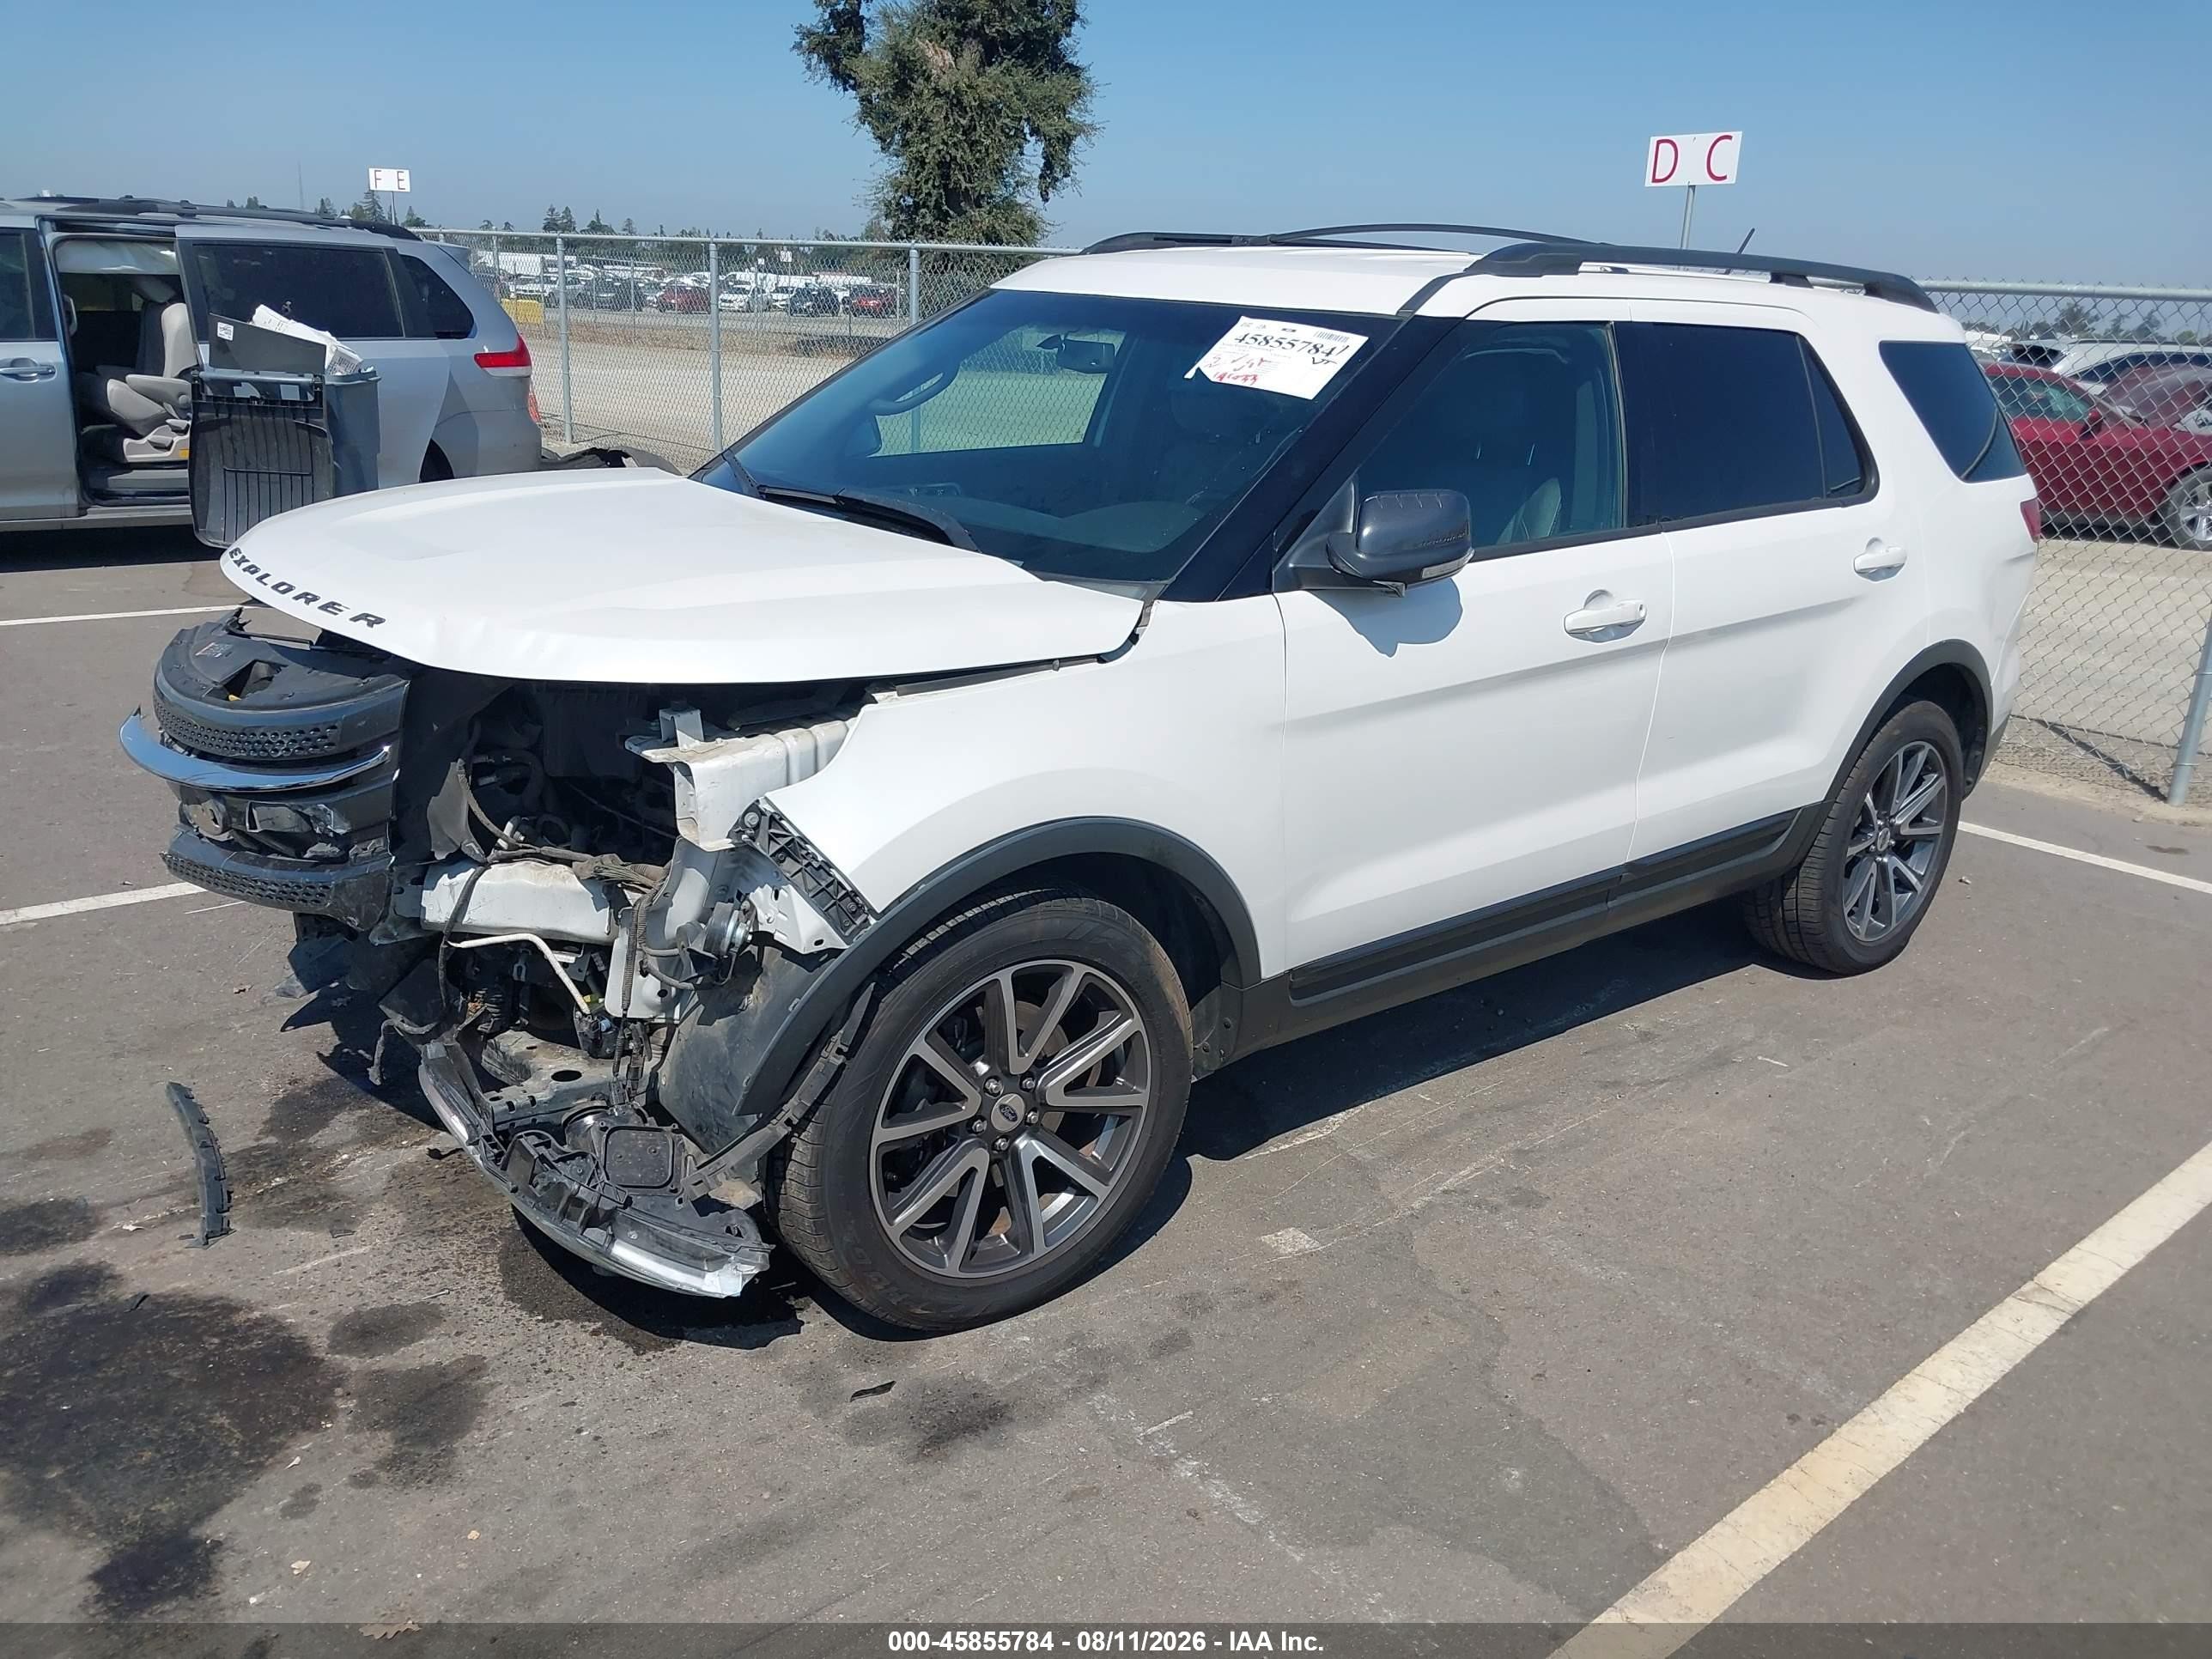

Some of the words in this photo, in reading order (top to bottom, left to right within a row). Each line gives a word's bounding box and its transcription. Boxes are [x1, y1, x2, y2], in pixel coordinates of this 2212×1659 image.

[374, 169, 382, 190] F
[397, 171, 406, 190] E
[1651, 138, 1679, 183] D
[1706, 135, 1733, 182] C
[228, 547, 386, 629] EXPLORER
